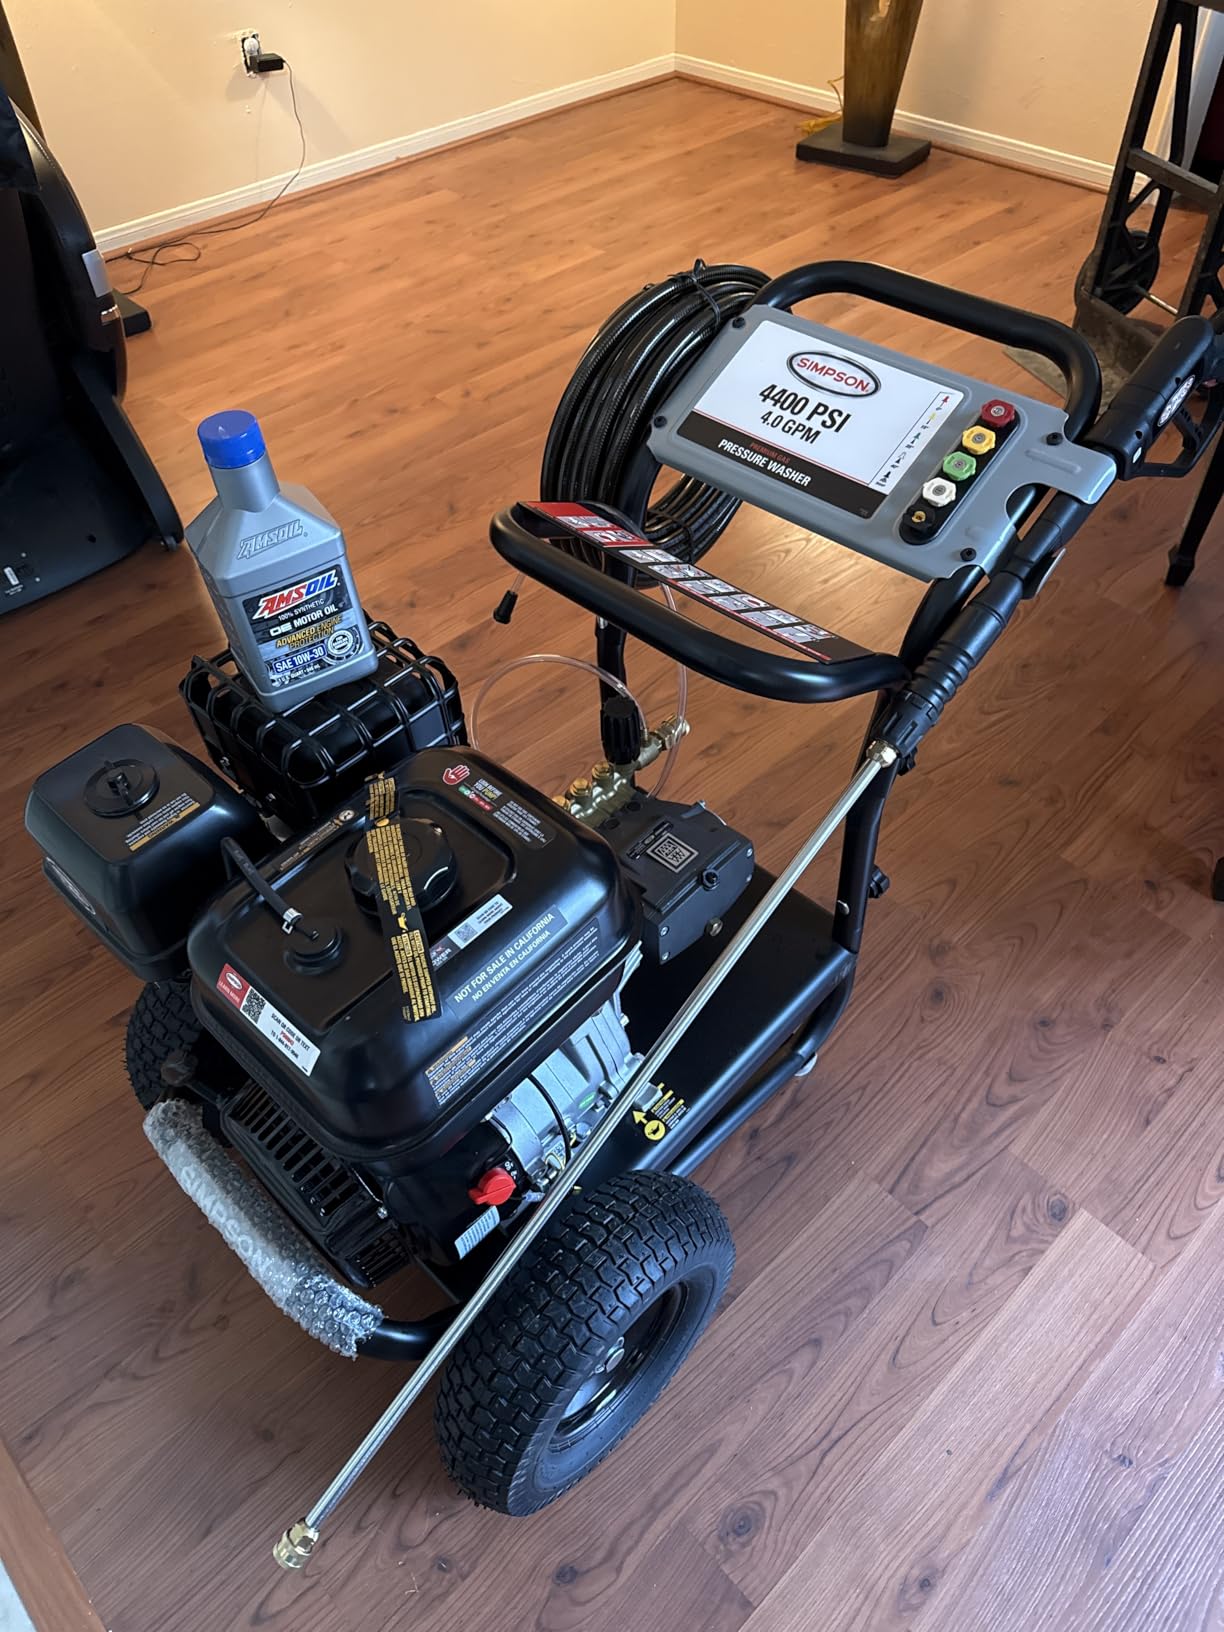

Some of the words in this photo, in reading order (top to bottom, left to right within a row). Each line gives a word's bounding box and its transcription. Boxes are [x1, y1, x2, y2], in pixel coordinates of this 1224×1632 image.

[797, 357, 870, 392] SIMPSON
[759, 384, 810, 416] 4400
[805, 402, 852, 433] PSI
[760, 411, 784, 428] 4.0
[781, 419, 822, 444] GPM
[718, 438, 769, 468] PRESSURE
[766, 460, 812, 487] WASHER
[238, 519, 304, 559] AMSOIL
[253, 569, 338, 619] AMSOIL
[278, 611, 294, 621] 100%
[294, 598, 325, 617] SYNTHETIC
[269, 622, 293, 637] OE
[293, 609, 324, 628] MOTOR
[324, 604, 339, 616] OIL
[276, 626, 316, 648] ADVANCED
[314, 616, 343, 633] ENGINE
[289, 628, 335, 649] PROTECTION
[275, 660, 294, 673] SAE
[293, 647, 325, 666] 10W-30
[454, 985, 472, 1003] NOT
[471, 972, 488, 988] FOR
[486, 956, 506, 975] SALE
[504, 946, 516, 959] IN
[513, 913, 555, 951] CALIFORNIA
[472, 990, 484, 1002] NO
[482, 981, 494, 993] EN
[491, 967, 511, 985] VENTA
[509, 958, 520, 969] EN
[518, 930, 551, 961] CALIFORNIA
[300, 1041, 311, 1052] TEXT
